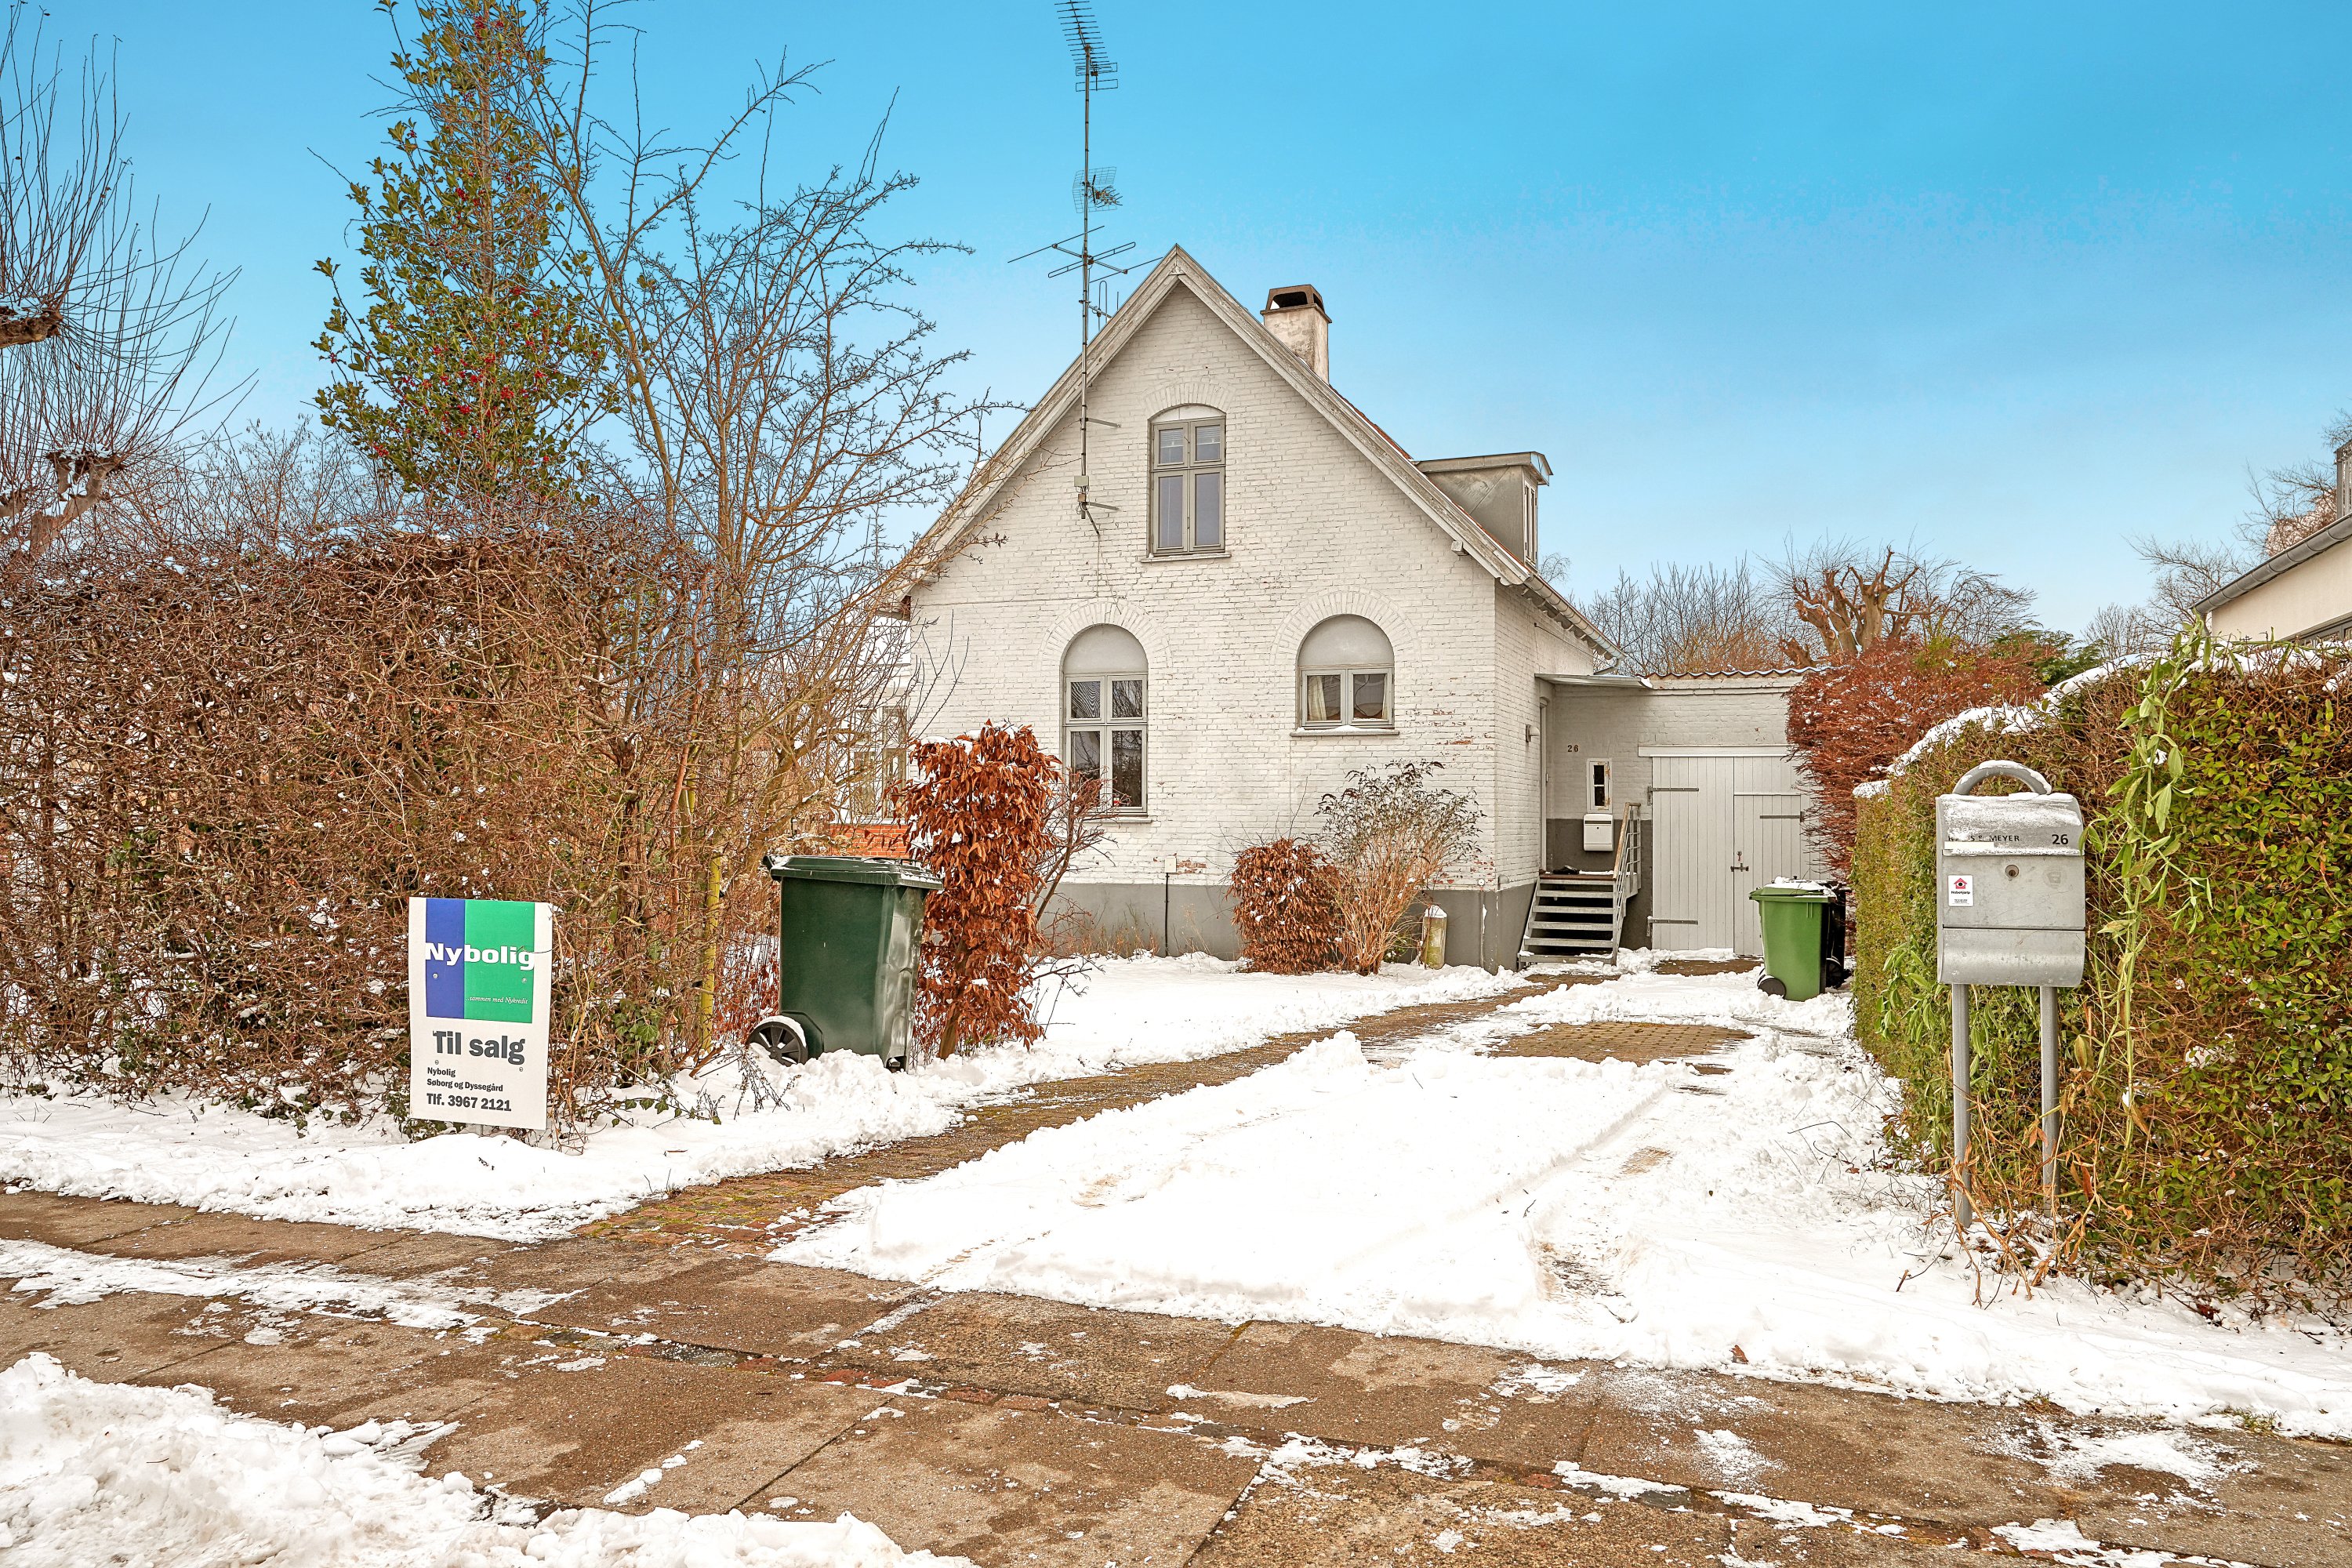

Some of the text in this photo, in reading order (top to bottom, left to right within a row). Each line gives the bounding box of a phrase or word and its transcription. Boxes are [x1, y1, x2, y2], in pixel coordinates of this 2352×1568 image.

[1567, 744, 1579, 753] 26
[2052, 833, 2069, 844] 26
[425, 942, 534, 971] Nybolig
[433, 1030, 525, 1065] Til salg
[427, 1067, 456, 1077] Nybolig
[426, 1078, 503, 1092] Søborg og Dyssegård
[426, 1093, 512, 1112] Tlf. 3967 2121
